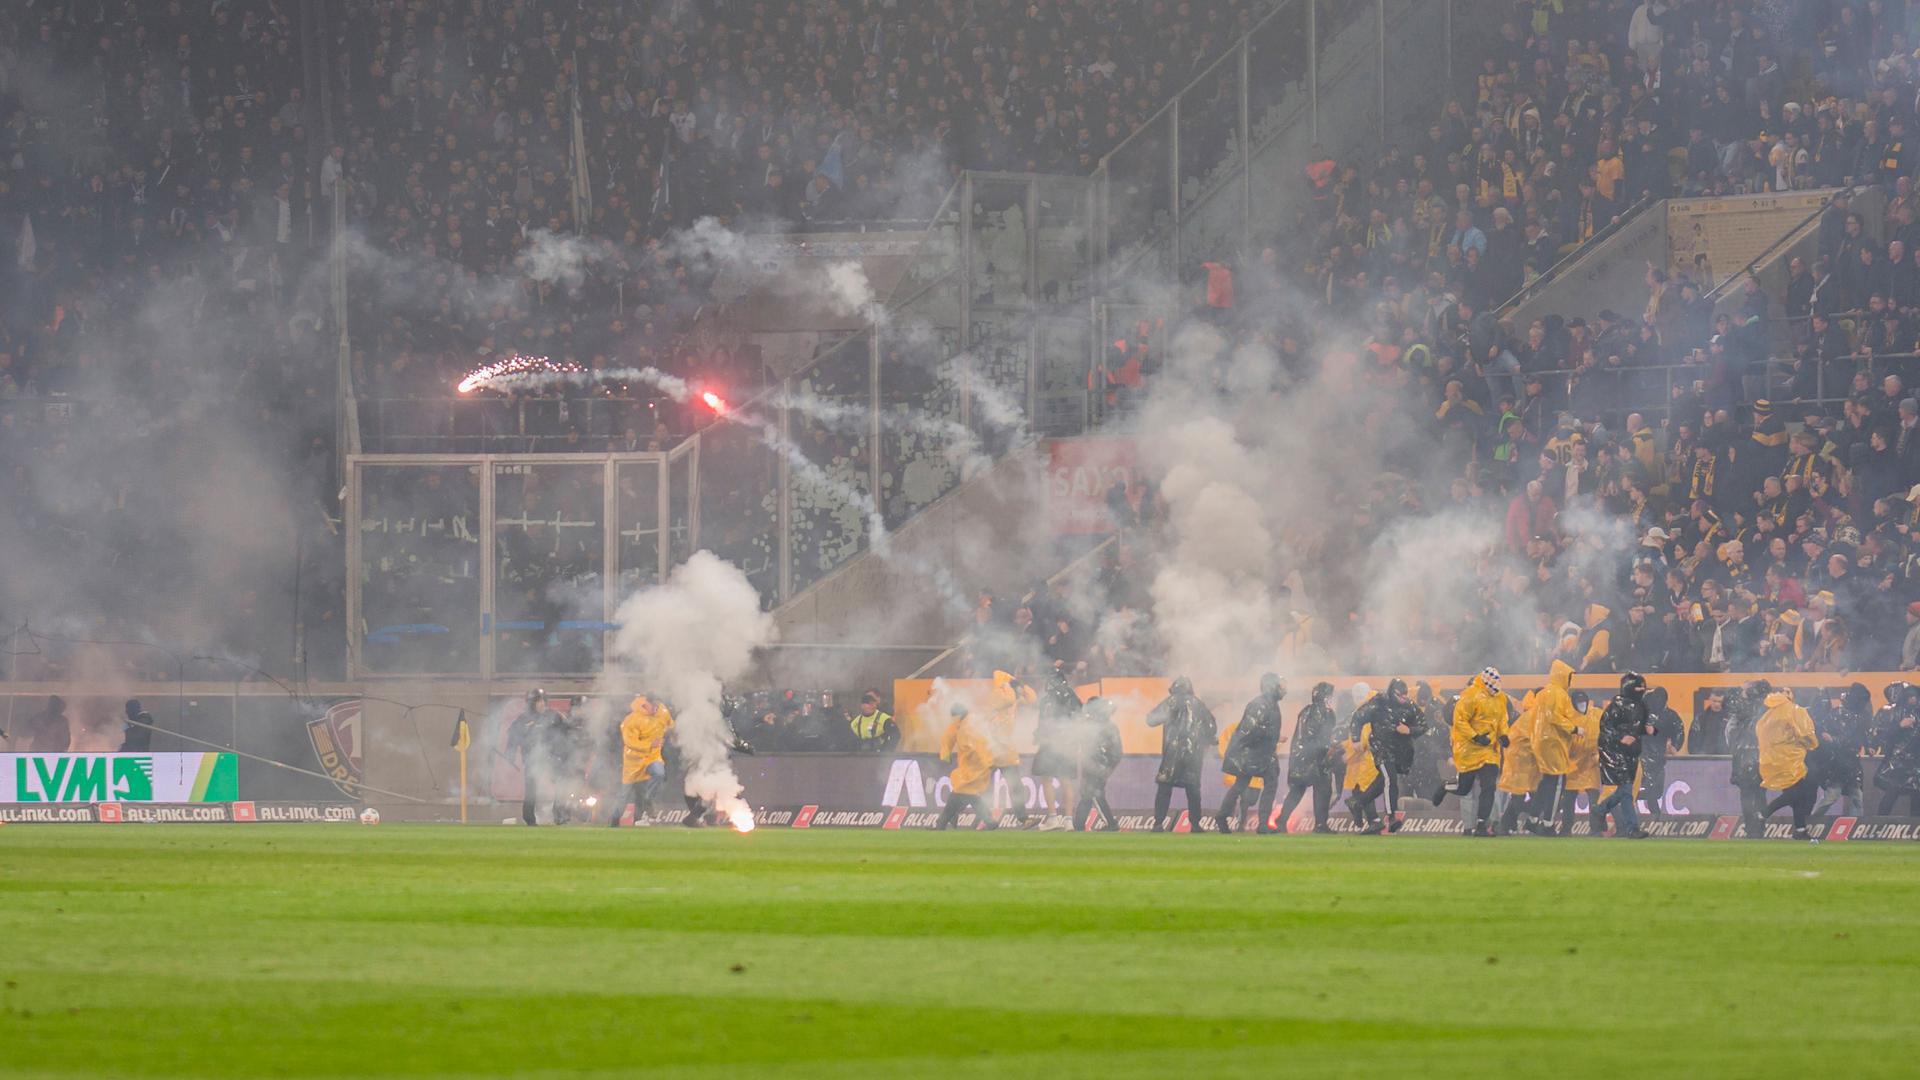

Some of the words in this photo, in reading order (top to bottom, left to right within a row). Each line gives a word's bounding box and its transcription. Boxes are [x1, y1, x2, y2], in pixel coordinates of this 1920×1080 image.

[16, 757, 107, 802] LVM
[0, 808, 92, 822] LL-INKL.COM
[128, 807, 226, 821] ALL-INKL.COM
[261, 807, 356, 820] ALL-INKL.COM
[813, 811, 884, 826] ALL-INKL.COM
